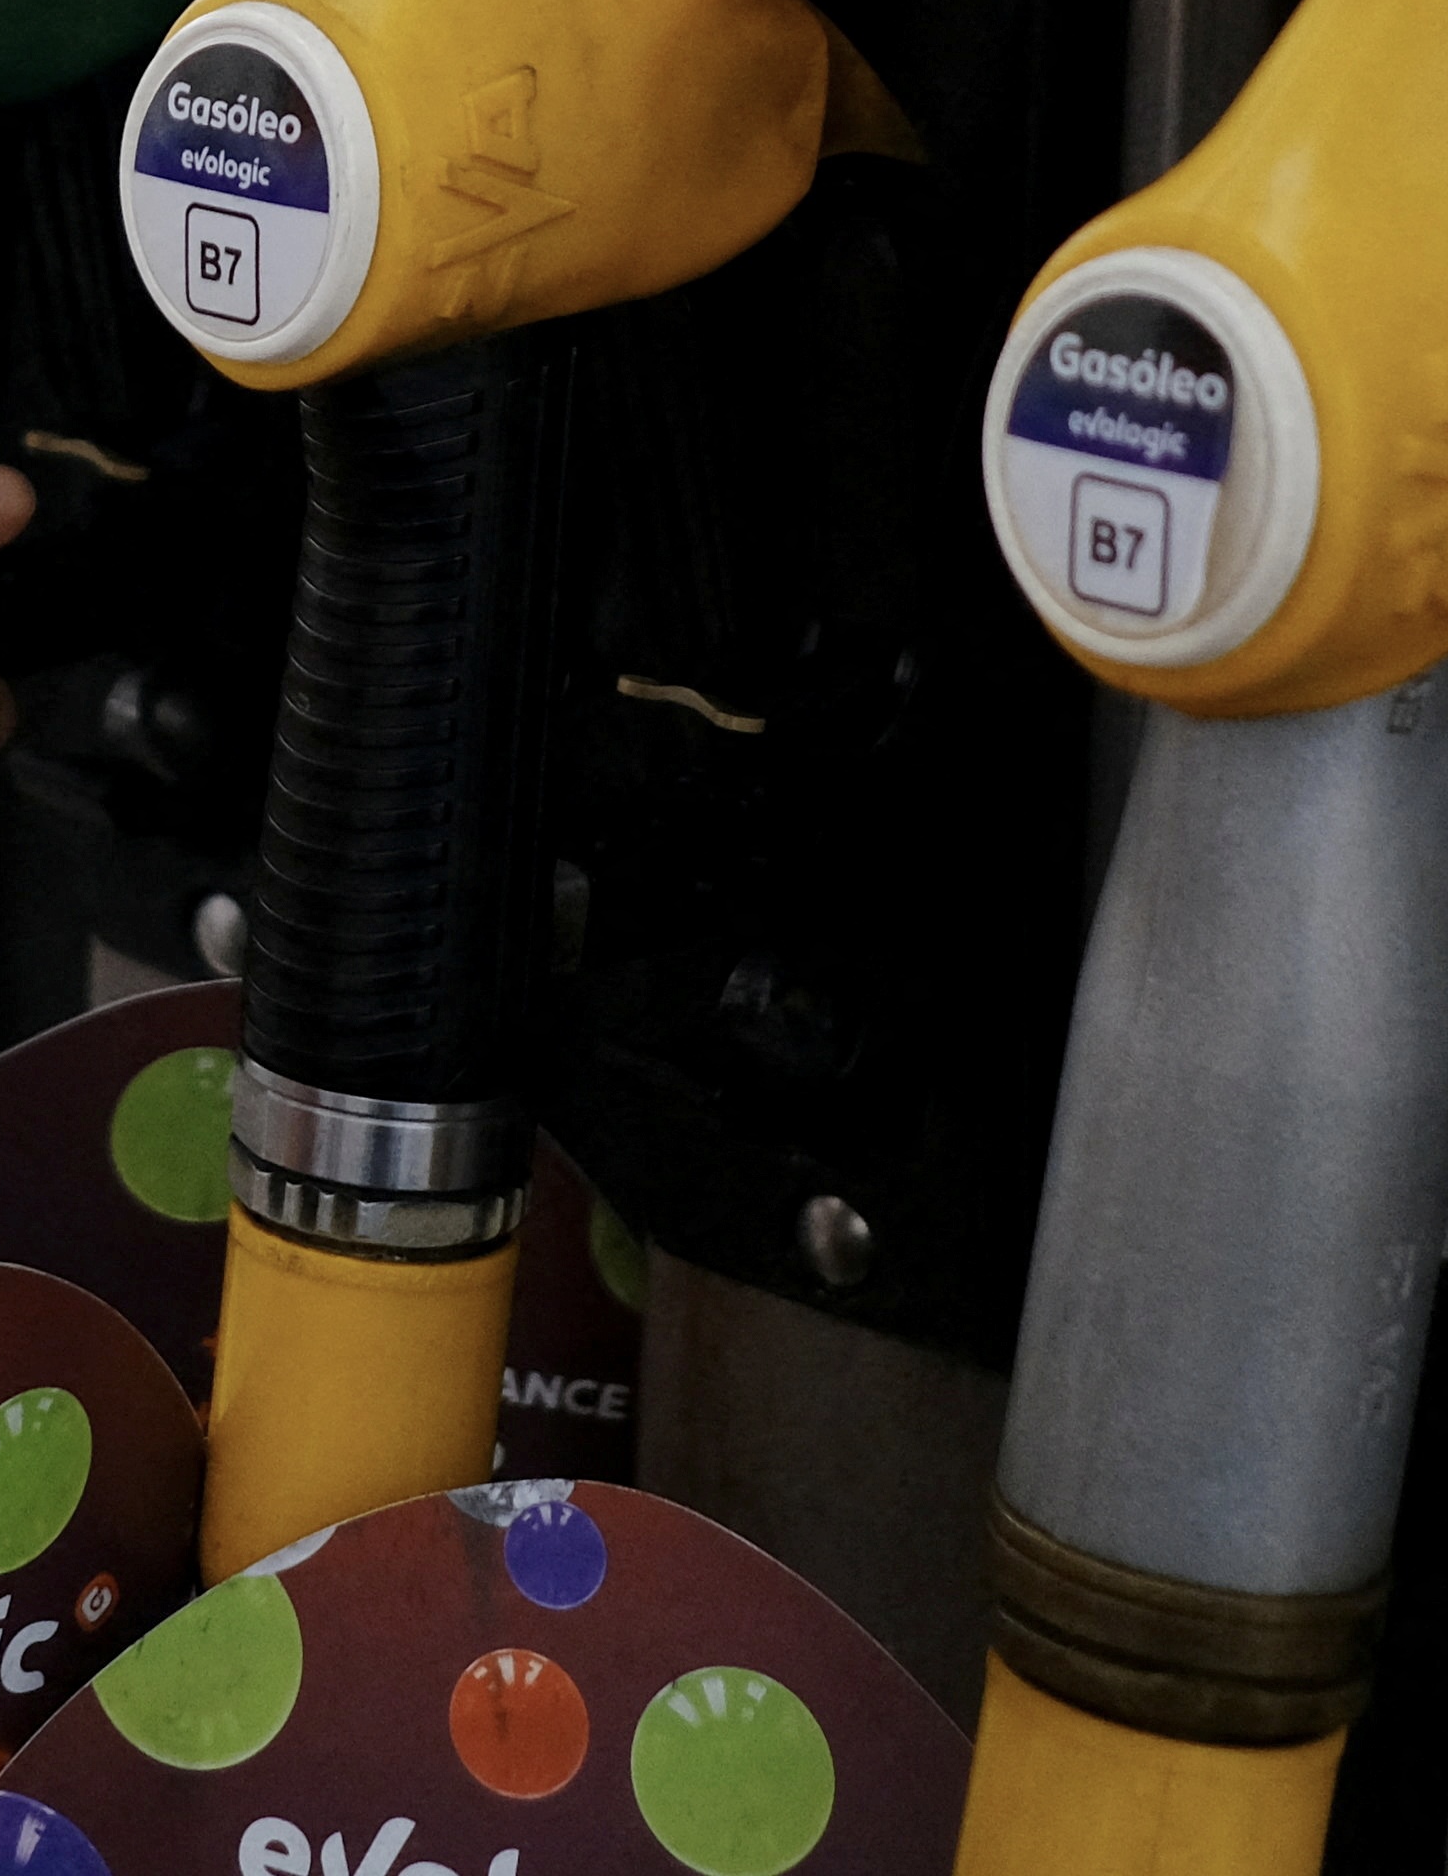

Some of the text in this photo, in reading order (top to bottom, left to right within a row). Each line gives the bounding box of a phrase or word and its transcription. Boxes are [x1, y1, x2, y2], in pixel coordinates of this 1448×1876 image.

[166, 80, 303, 145] Gasóleo
[180, 144, 272, 190] evologic
[199, 240, 243, 286] B7
[1048, 330, 1228, 411] Gasóleo
[1066, 406, 1190, 463] evologic
[1088, 517, 1145, 571] B7
[237, 1814, 522, 1876] ev
